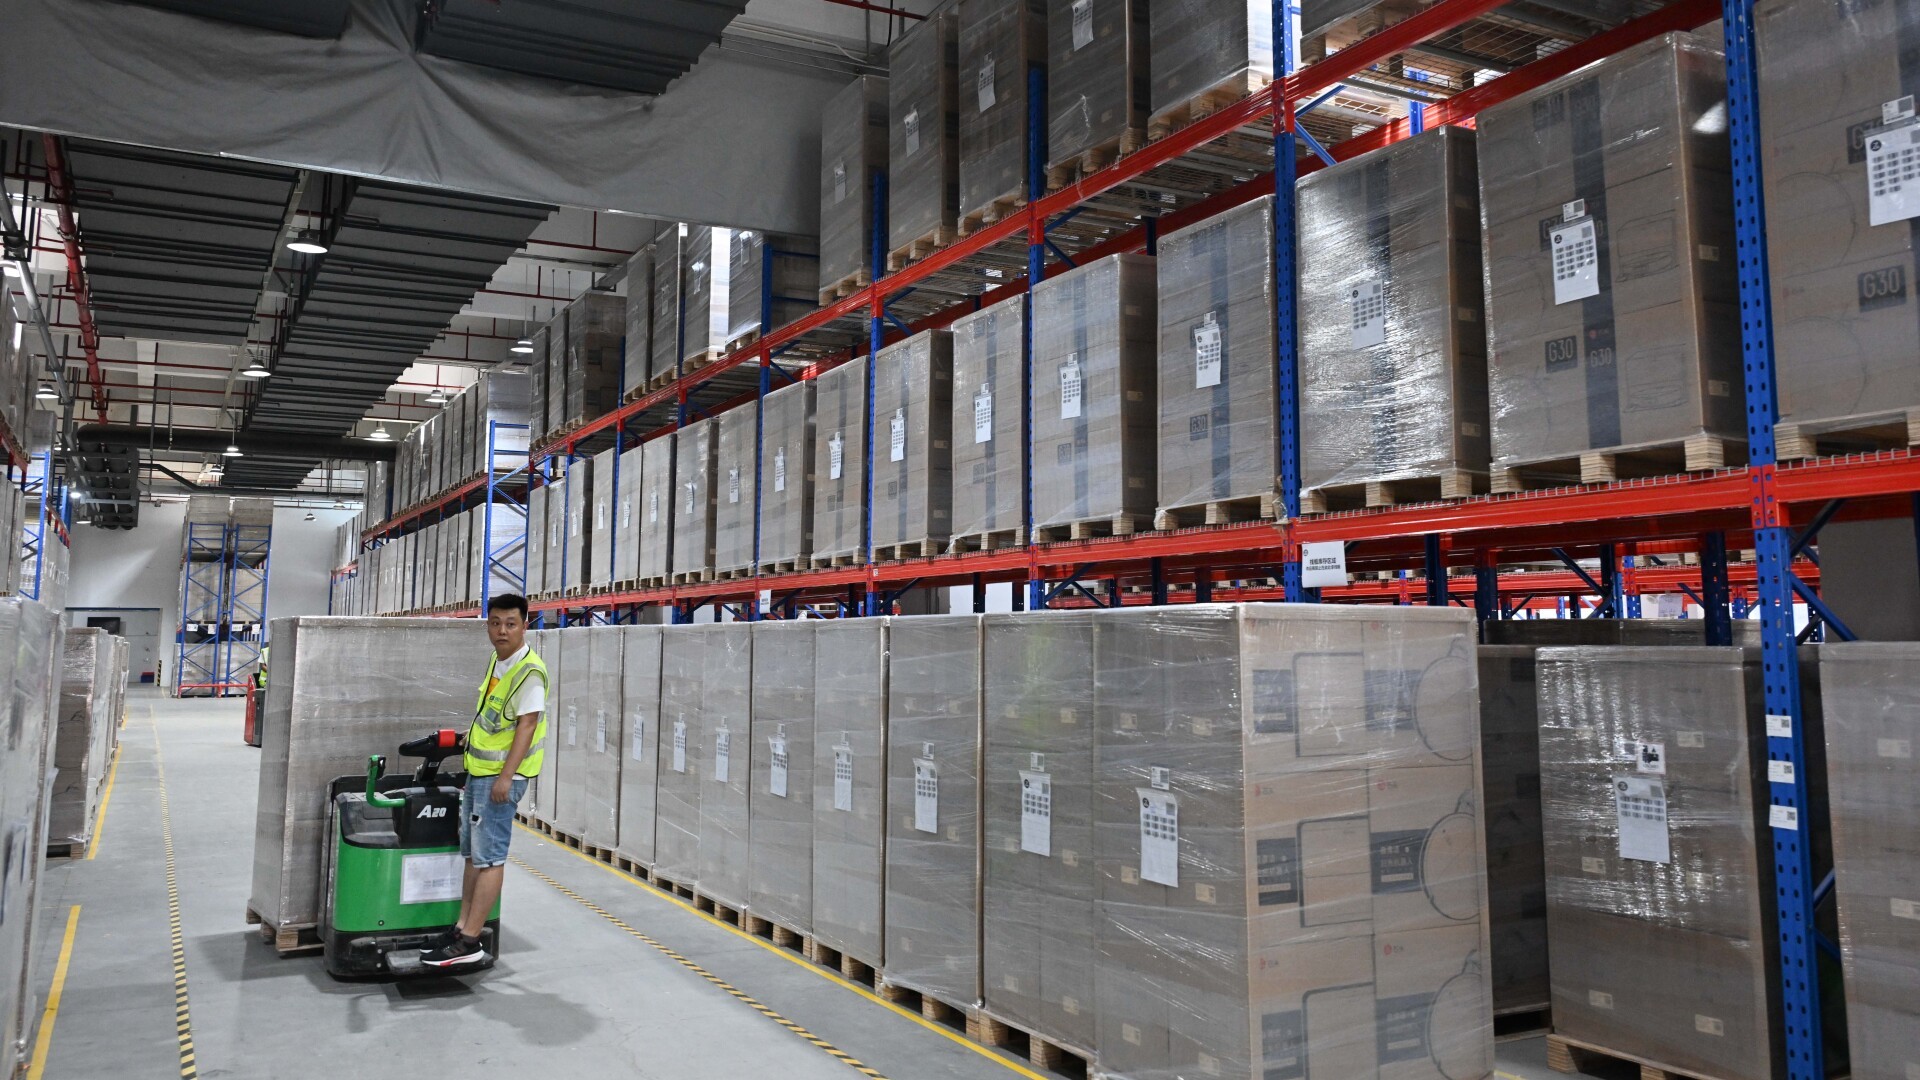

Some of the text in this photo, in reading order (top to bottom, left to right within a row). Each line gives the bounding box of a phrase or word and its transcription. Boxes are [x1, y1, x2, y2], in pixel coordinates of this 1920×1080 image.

[1863, 269, 1899, 298] G30
[1549, 338, 1574, 362] G30
[1591, 348, 1611, 368] G30
[417, 804, 447, 818] A20
